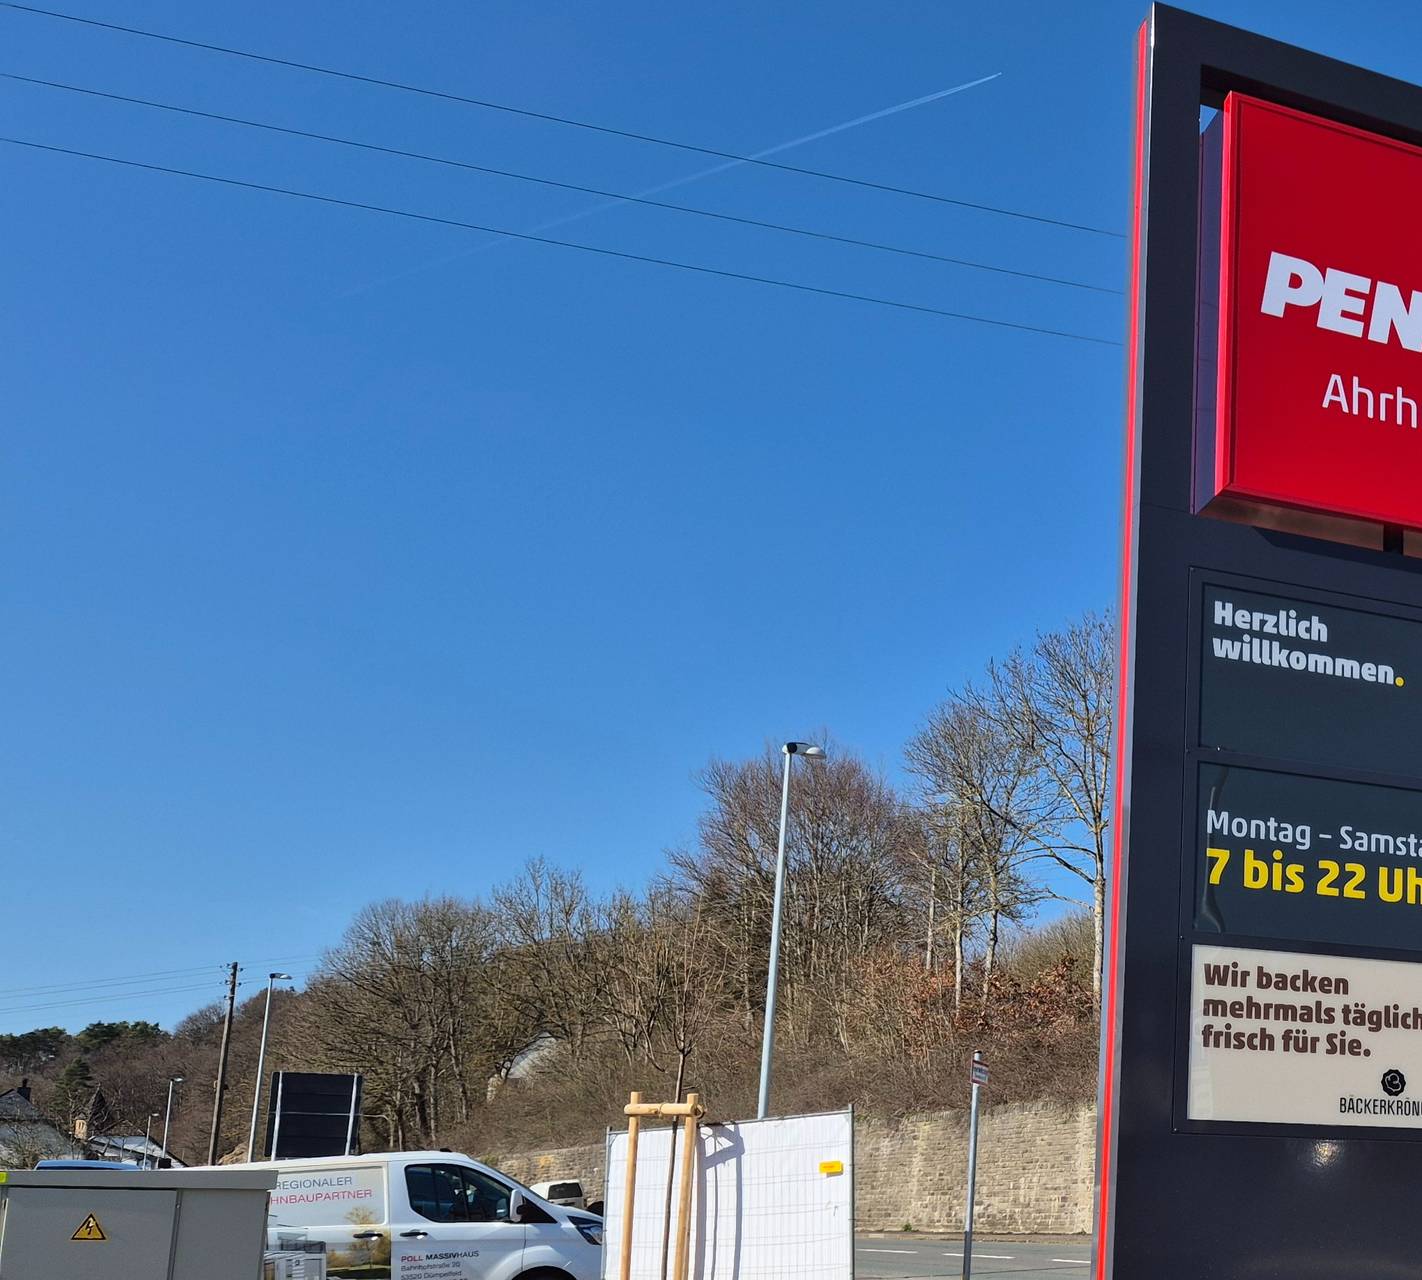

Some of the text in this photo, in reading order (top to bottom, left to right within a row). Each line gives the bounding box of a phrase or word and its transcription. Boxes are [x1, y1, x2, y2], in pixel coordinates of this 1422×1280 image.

[1214, 601, 1328, 643] Herzlich
[1213, 634, 1405, 688] willkommen.
[1206, 809, 1311, 851] Montag
[1206, 848, 1230, 885] 7
[1244, 850, 1305, 894] bis
[1316, 860, 1366, 900] 22
[1203, 962, 1350, 996] Wir backen
[1203, 997, 1336, 1026] mehrmals
[1201, 1023, 1372, 1058] frisch für Sie.
[270, 1188, 373, 1205] HNBAUPARTNER
[276, 1176, 352, 1190] REGIONALER
[401, 1250, 480, 1263] POLL MASSIVHAUS
